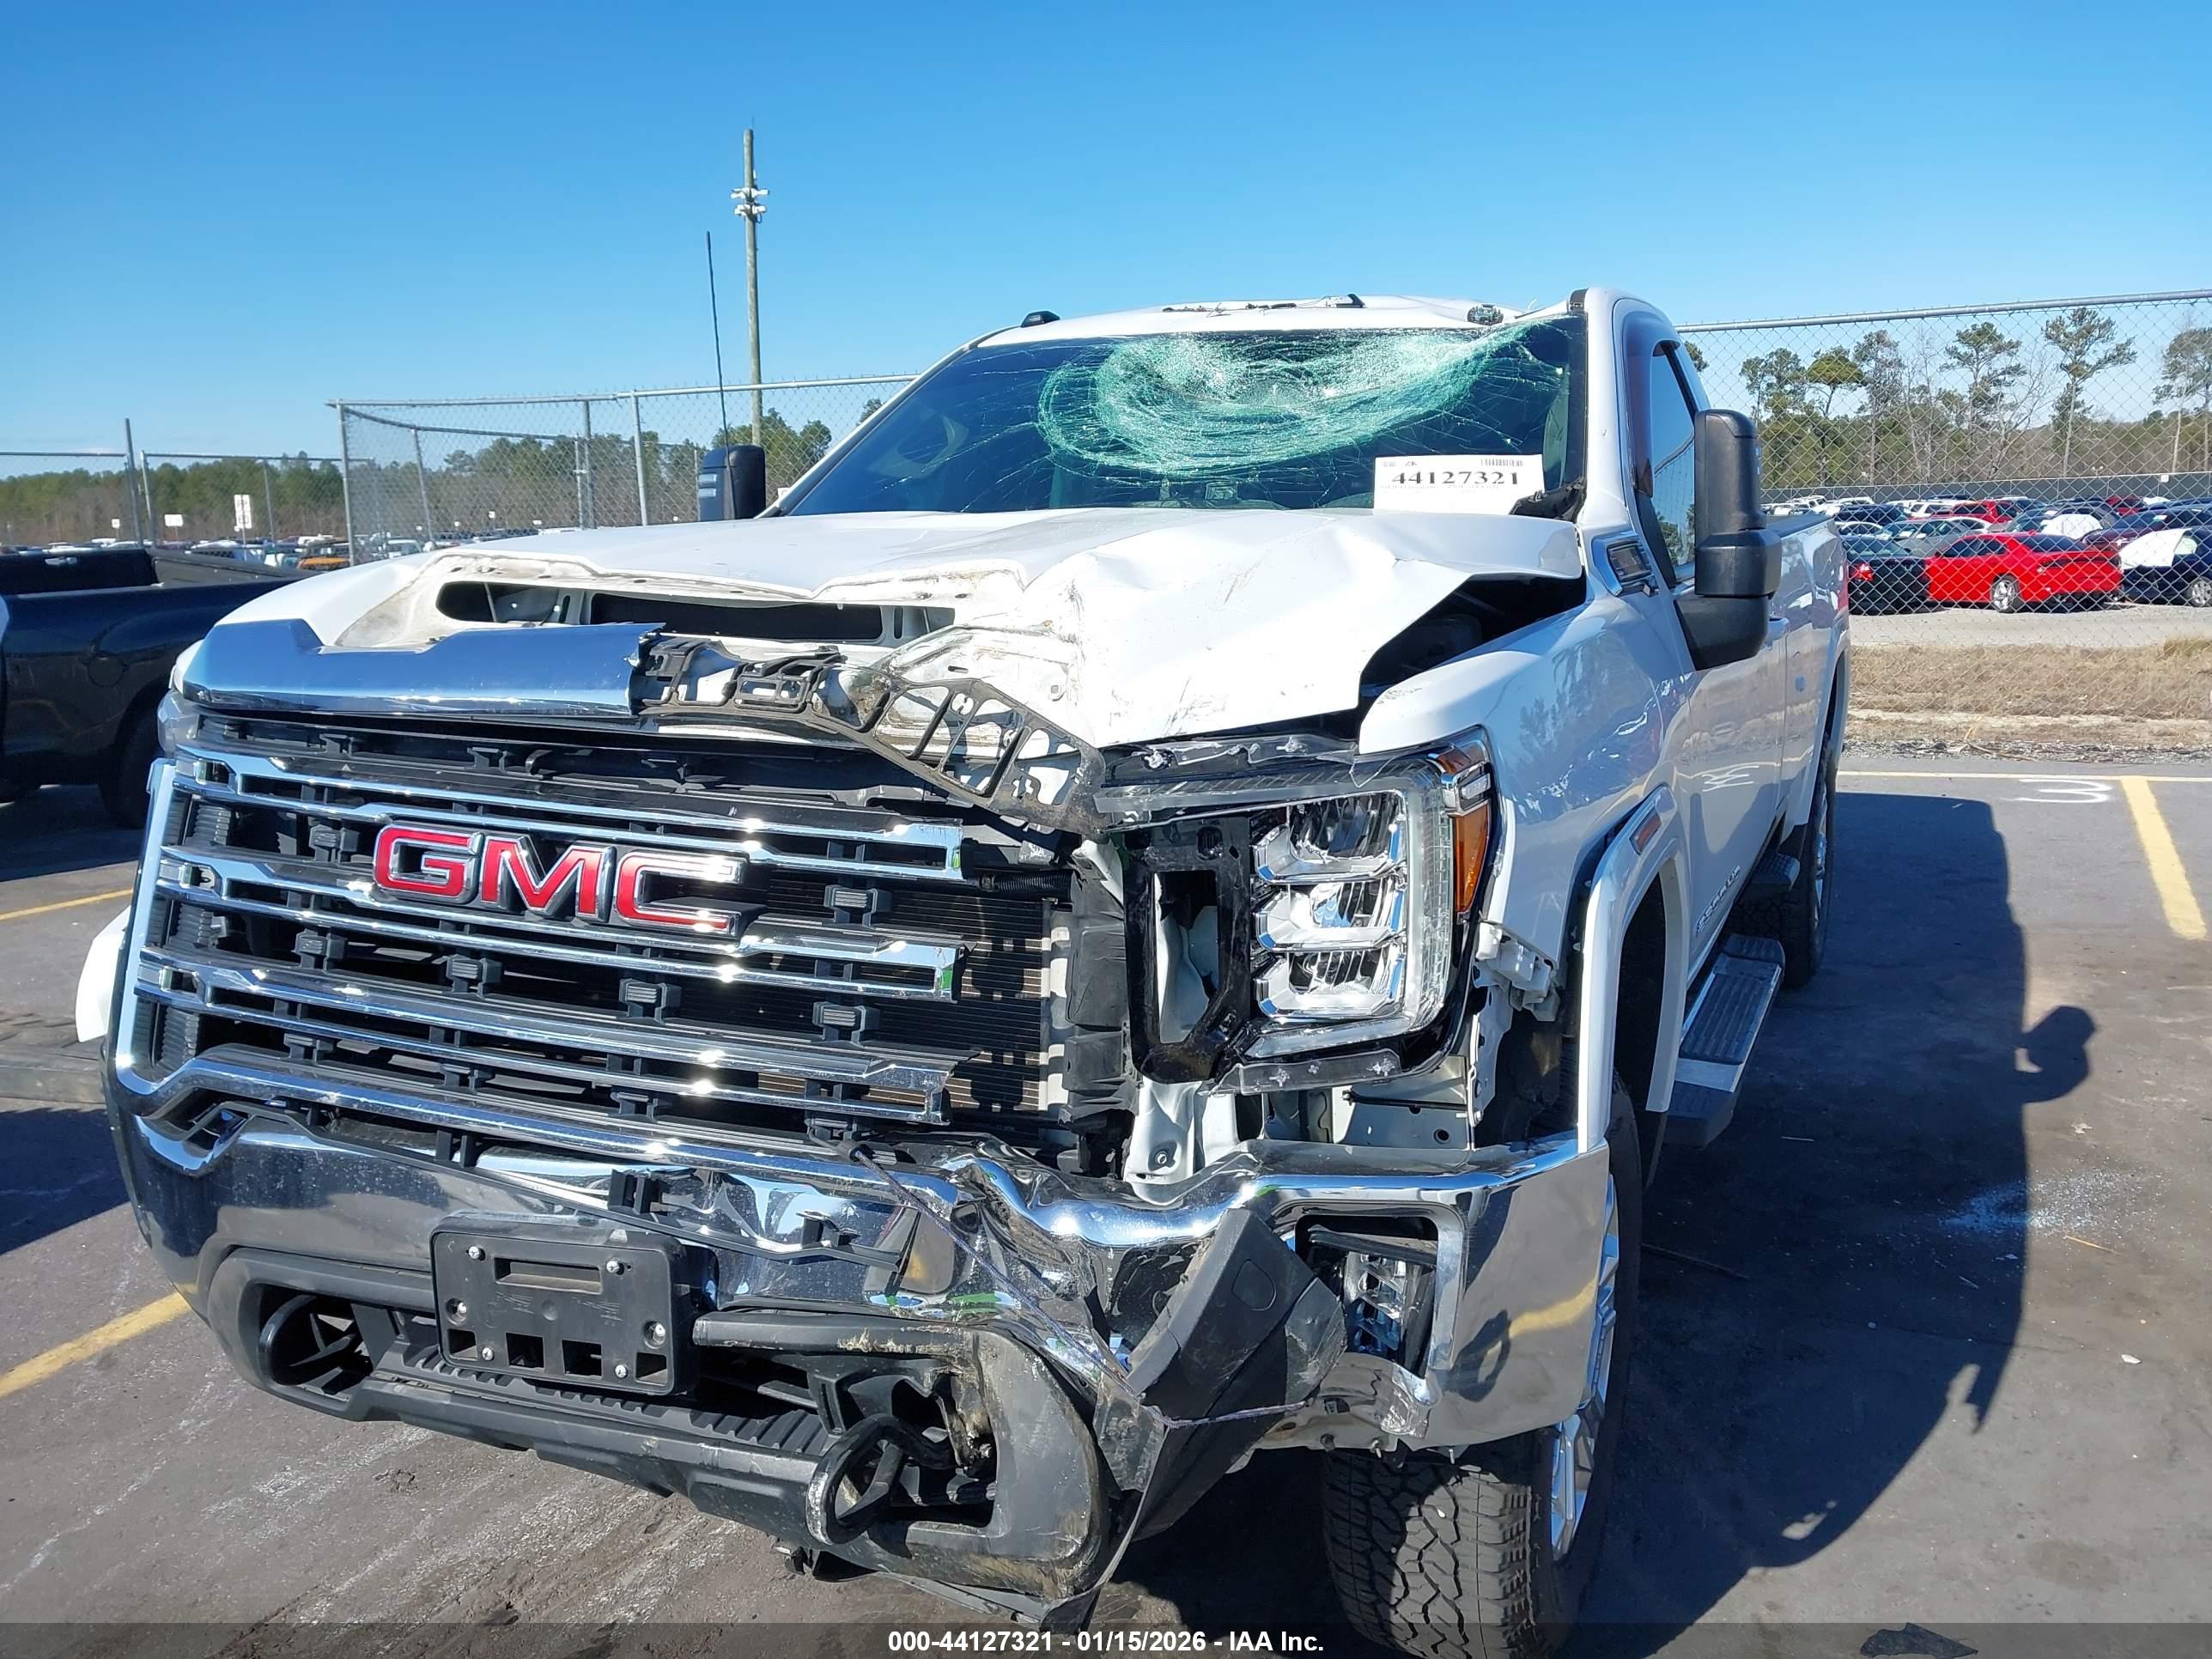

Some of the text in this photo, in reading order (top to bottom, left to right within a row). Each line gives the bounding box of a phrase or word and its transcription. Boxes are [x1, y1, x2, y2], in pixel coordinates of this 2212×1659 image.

[1392, 471, 1519, 485] 44127321
[2009, 777, 2112, 804] 3
[373, 823, 749, 938] GMC
